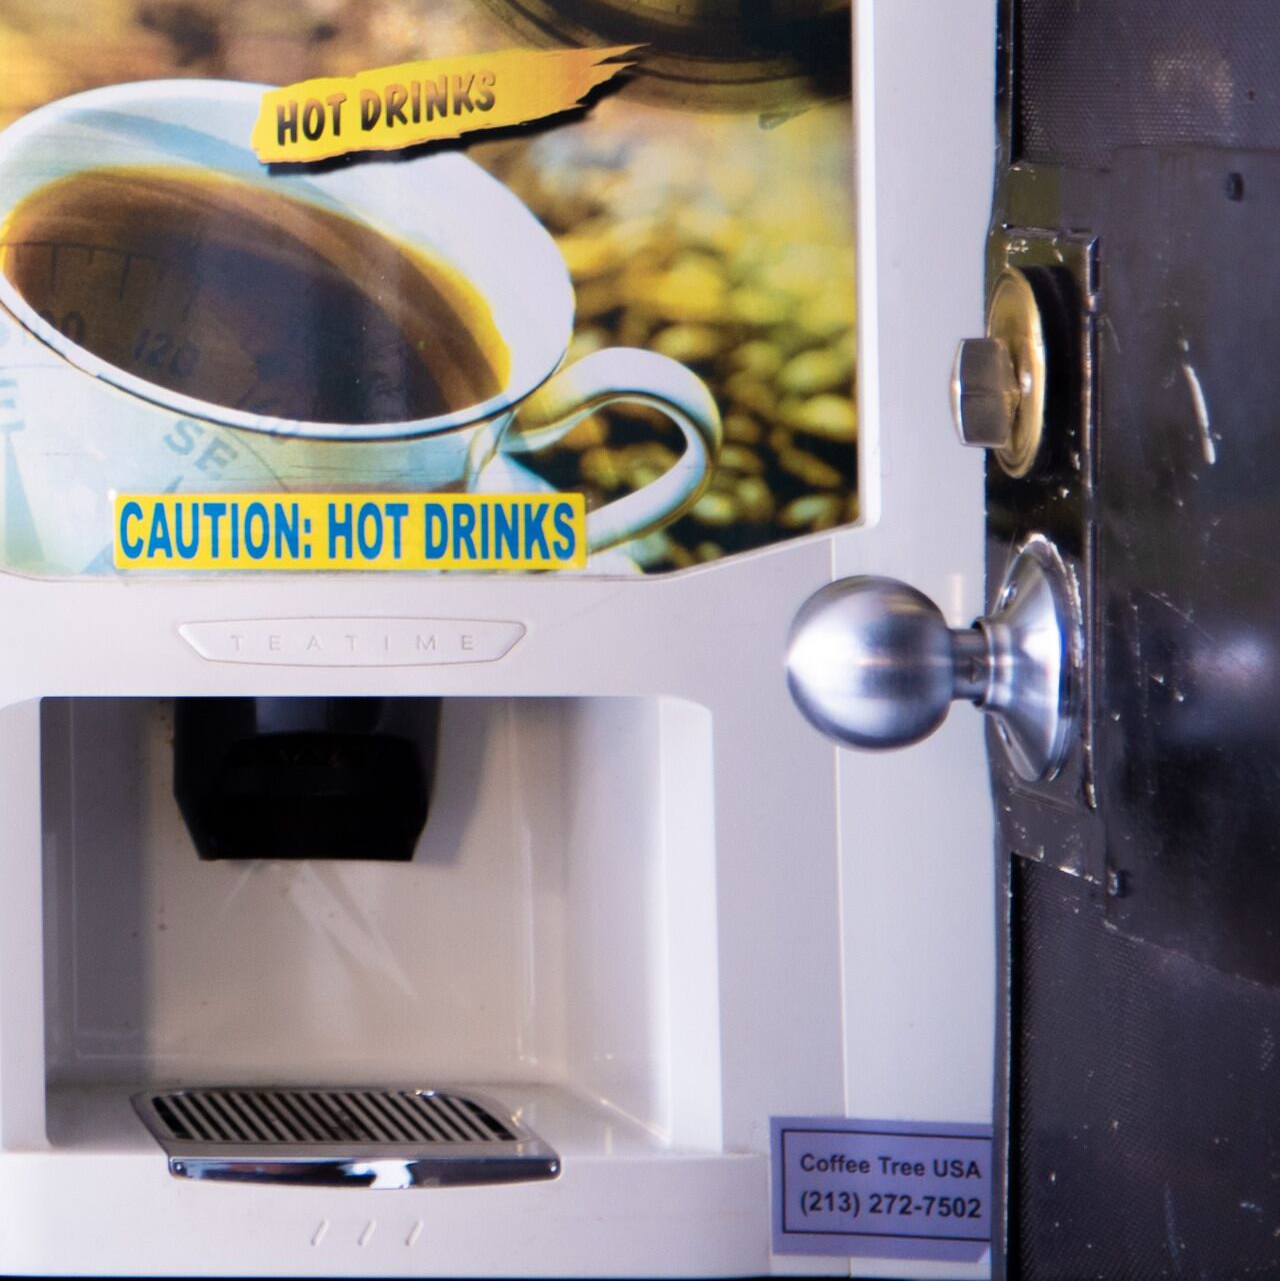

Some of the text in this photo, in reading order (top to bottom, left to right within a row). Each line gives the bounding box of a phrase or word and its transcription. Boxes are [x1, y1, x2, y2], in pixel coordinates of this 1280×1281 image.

[275, 69, 497, 146] HOT DRINKS
[118, 501, 576, 560] CAUTION: HOT DRINKS
[800, 1153, 982, 1180] Coffee Tree USA
[800, 1190, 982, 1219] (213) 272-7502
